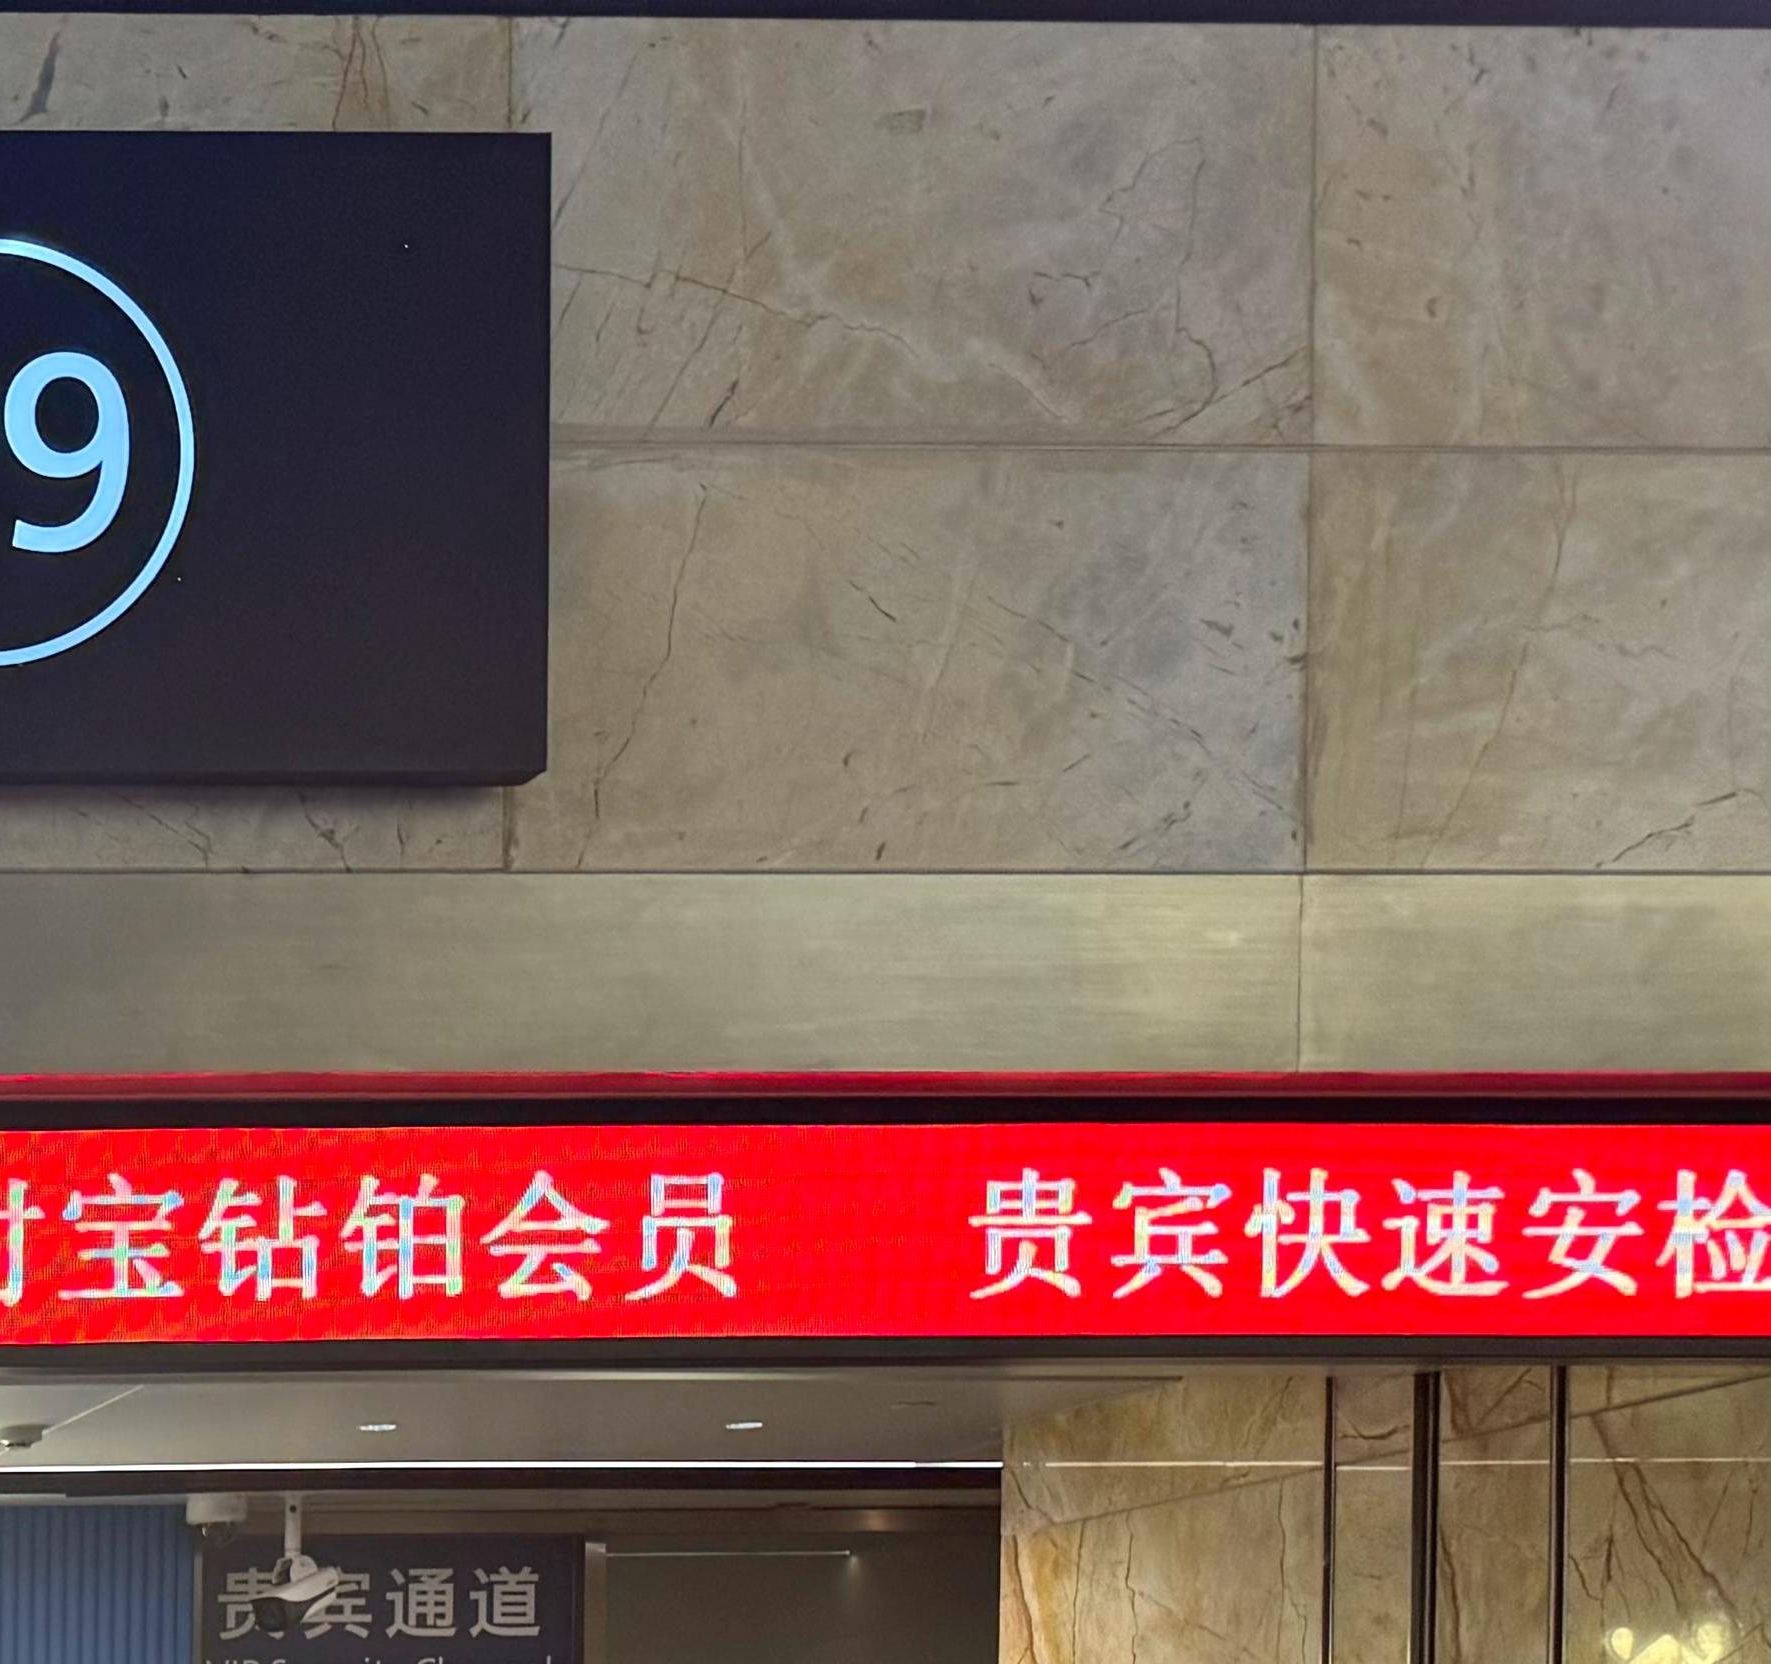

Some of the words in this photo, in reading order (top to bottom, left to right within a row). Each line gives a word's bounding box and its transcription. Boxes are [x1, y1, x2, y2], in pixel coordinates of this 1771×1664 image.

[968, 1167, 1771, 1299] 贵宾快速安检
